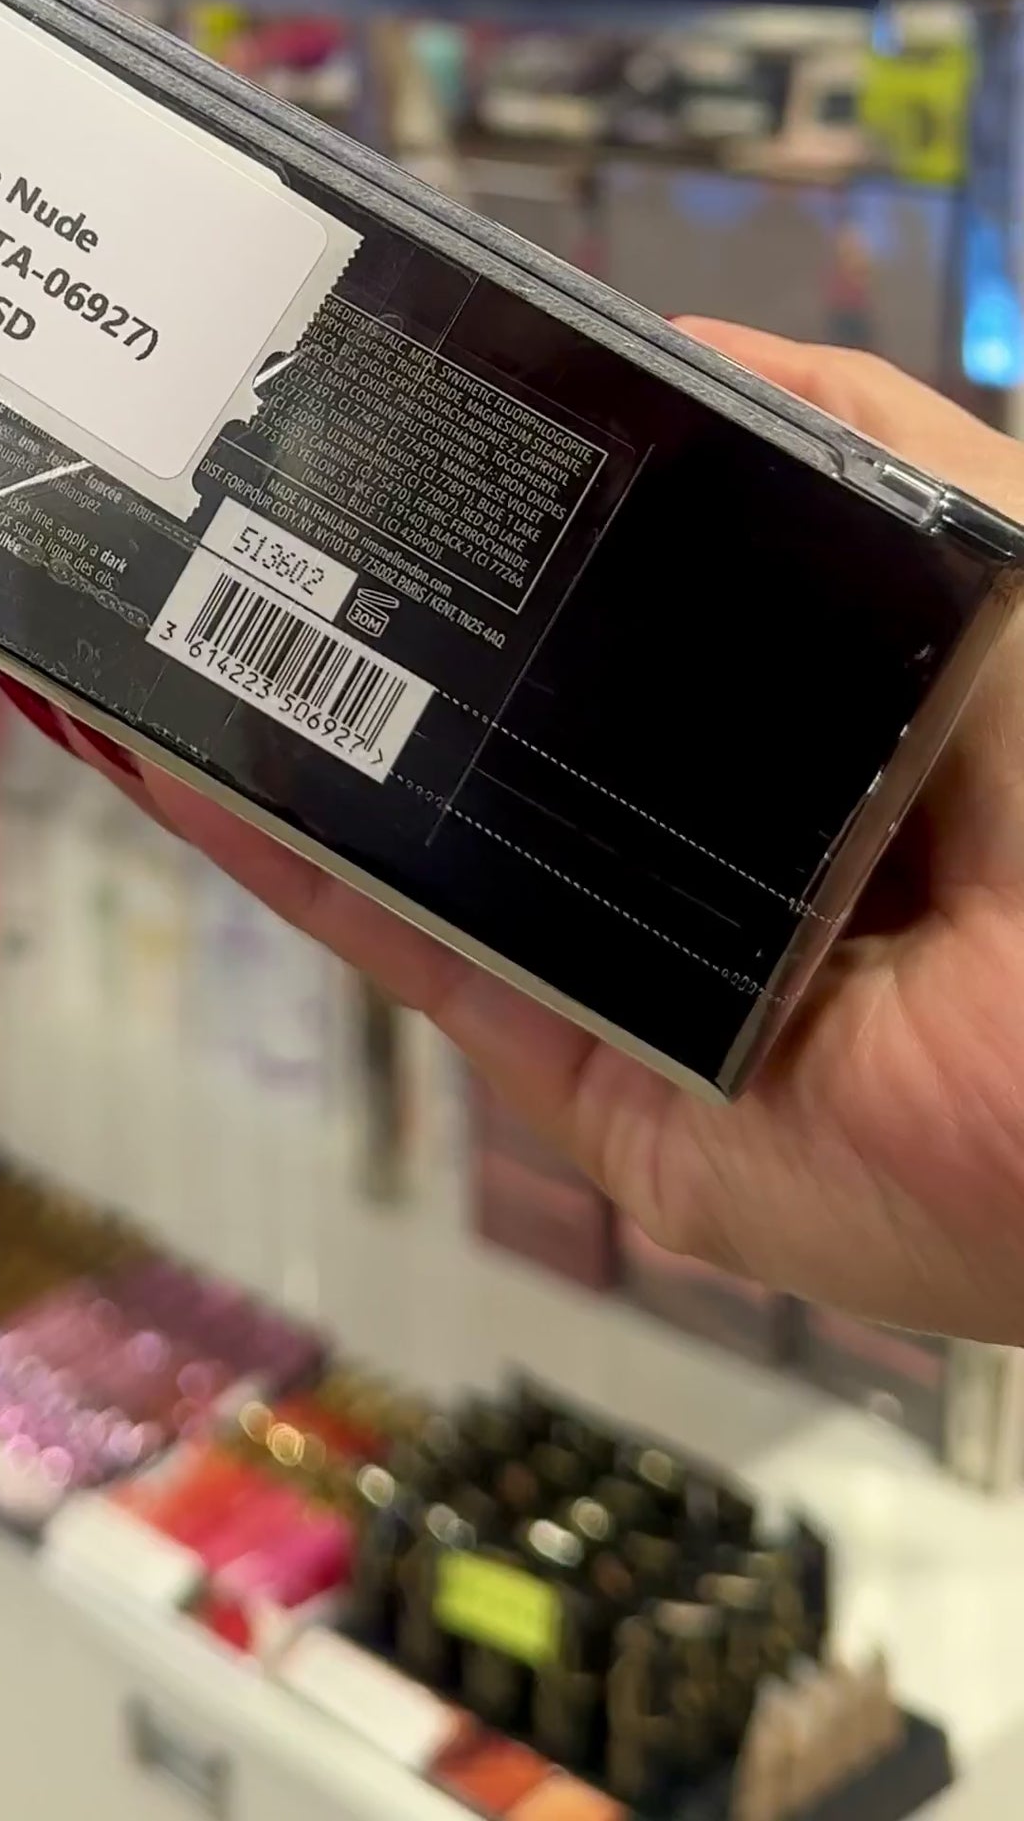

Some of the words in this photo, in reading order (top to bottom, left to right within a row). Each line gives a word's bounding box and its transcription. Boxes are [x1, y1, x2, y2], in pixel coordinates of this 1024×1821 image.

[6, 177, 99, 253] Nude
[321, 294, 384, 341] GREDIENTS:
[378, 328, 411, 357] TALC,
[437, 362, 497, 407] SYNTHETIC
[492, 393, 597, 467] FLUORPHLOGOPITE,
[357, 371, 396, 402] OXIDE,
[392, 390, 494, 462] PHENOXYETHANOL,
[489, 447, 561, 500] TOCOPHERYL
[390, 353, 467, 409] TRIGLYCERIDE,
[463, 395, 533, 447] MAGNESIUM
[529, 434, 587, 478] STEARATE,
[416, 385, 522, 460] POLYACYLADIPATE-2,
[517, 446, 573, 489] CAPRYLYL
[306, 432, 358, 472] CARMINE
[411, 494, 453, 528] FERRIC
[448, 515, 531, 575] FERROCYANIDE
[324, 424, 406, 483] ULTRAMARINES
[417, 479, 464, 517] 77007),
[458, 504, 485, 528] RED
[481, 517, 501, 536] 40
[497, 526, 529, 553] LAKE
[325, 407, 378, 447] TITANIUM
[374, 435, 422, 473] DIOXIDE
[417, 461, 438, 482] (CI
[433, 470, 480, 508] 77891),
[475, 495, 507, 522] BLUE
[511, 516, 543, 544] LAKE
[345, 493, 377, 520] BLUE
[346, 382, 424, 438] CONTAIN/PEUT
[496, 471, 528, 498] IRON
[524, 487, 568, 522] OXIDES
[348, 402, 390, 436] 77492,
[439, 454, 509, 506] MANGANESE
[503, 493, 545, 527] VIOLET
[41, 536, 76, 567] ligne
[71, 553, 97, 578] des
[54, 521, 91, 553] apply
[97, 546, 130, 575] dark
[198, 456, 227, 482] DIST.
[325, 532, 363, 564] 10118
[362, 554, 400, 585] 75002
[394, 573, 429, 603] PARIS
[426, 593, 460, 622] KENT,
[453, 608, 486, 637] TN25
[231, 523, 327, 598] 513602
[265, 476, 301, 506] MADE
[296, 495, 313, 513] IN
[307, 501, 361, 542] THAILAND
[358, 531, 455, 600] rimmellondon.com
[294, 444, 339, 479] YELLOW
[386, 498, 432, 535] 19140),
[427, 522, 466, 554] BLACK
[486, 557, 527, 590] 77266
[348, 606, 383, 635] 30M
[157, 618, 179, 643] 3
[186, 635, 275, 702] 614223
[277, 690, 368, 758] 506927
